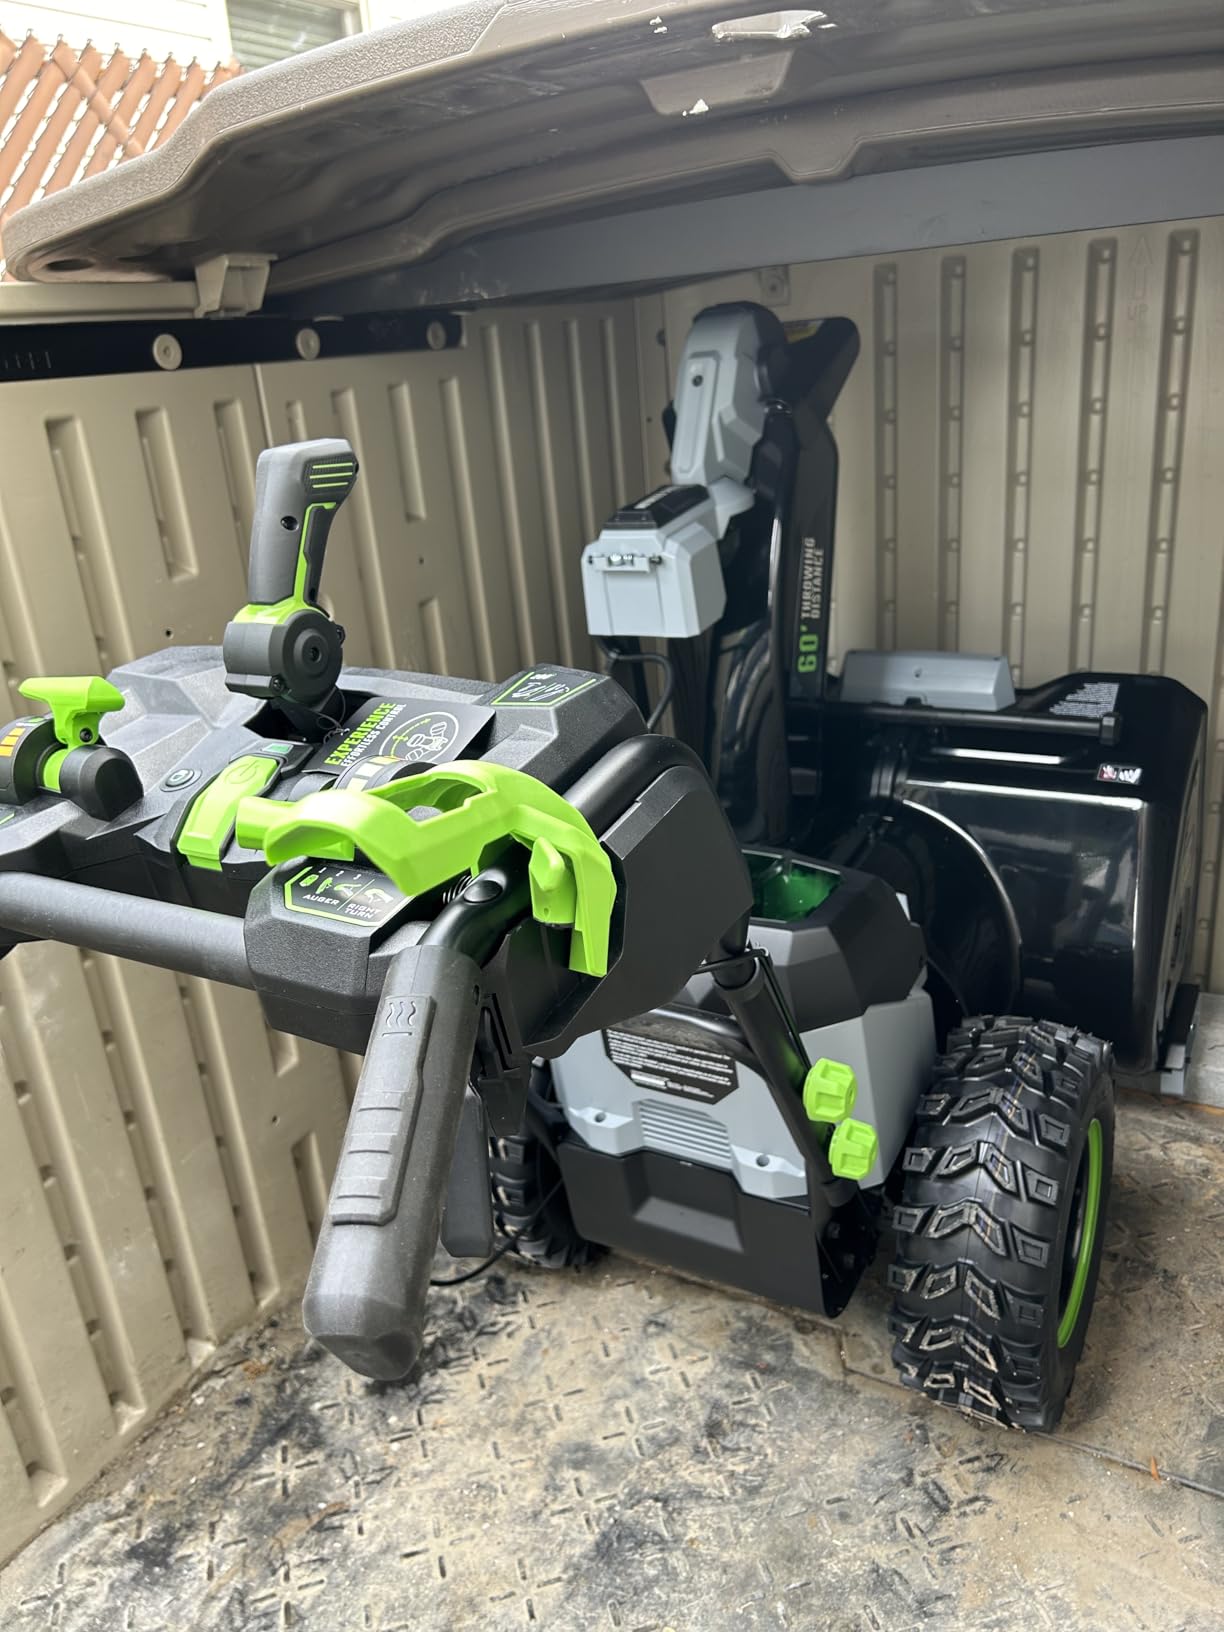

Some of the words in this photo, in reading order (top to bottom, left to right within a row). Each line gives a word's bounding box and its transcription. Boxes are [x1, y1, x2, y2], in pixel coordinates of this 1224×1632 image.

[801, 537, 816, 619] THROWING
[811, 549, 824, 619] DISTANCE
[324, 703, 396, 765] EXPERIENCE
[340, 730, 381, 767] EFFORTLESS
[375, 703, 407, 730] CONTROL
[302, 894, 340, 906] AUGER
[344, 908, 374, 919] TURN
[347, 903, 382, 914] RIGHT
